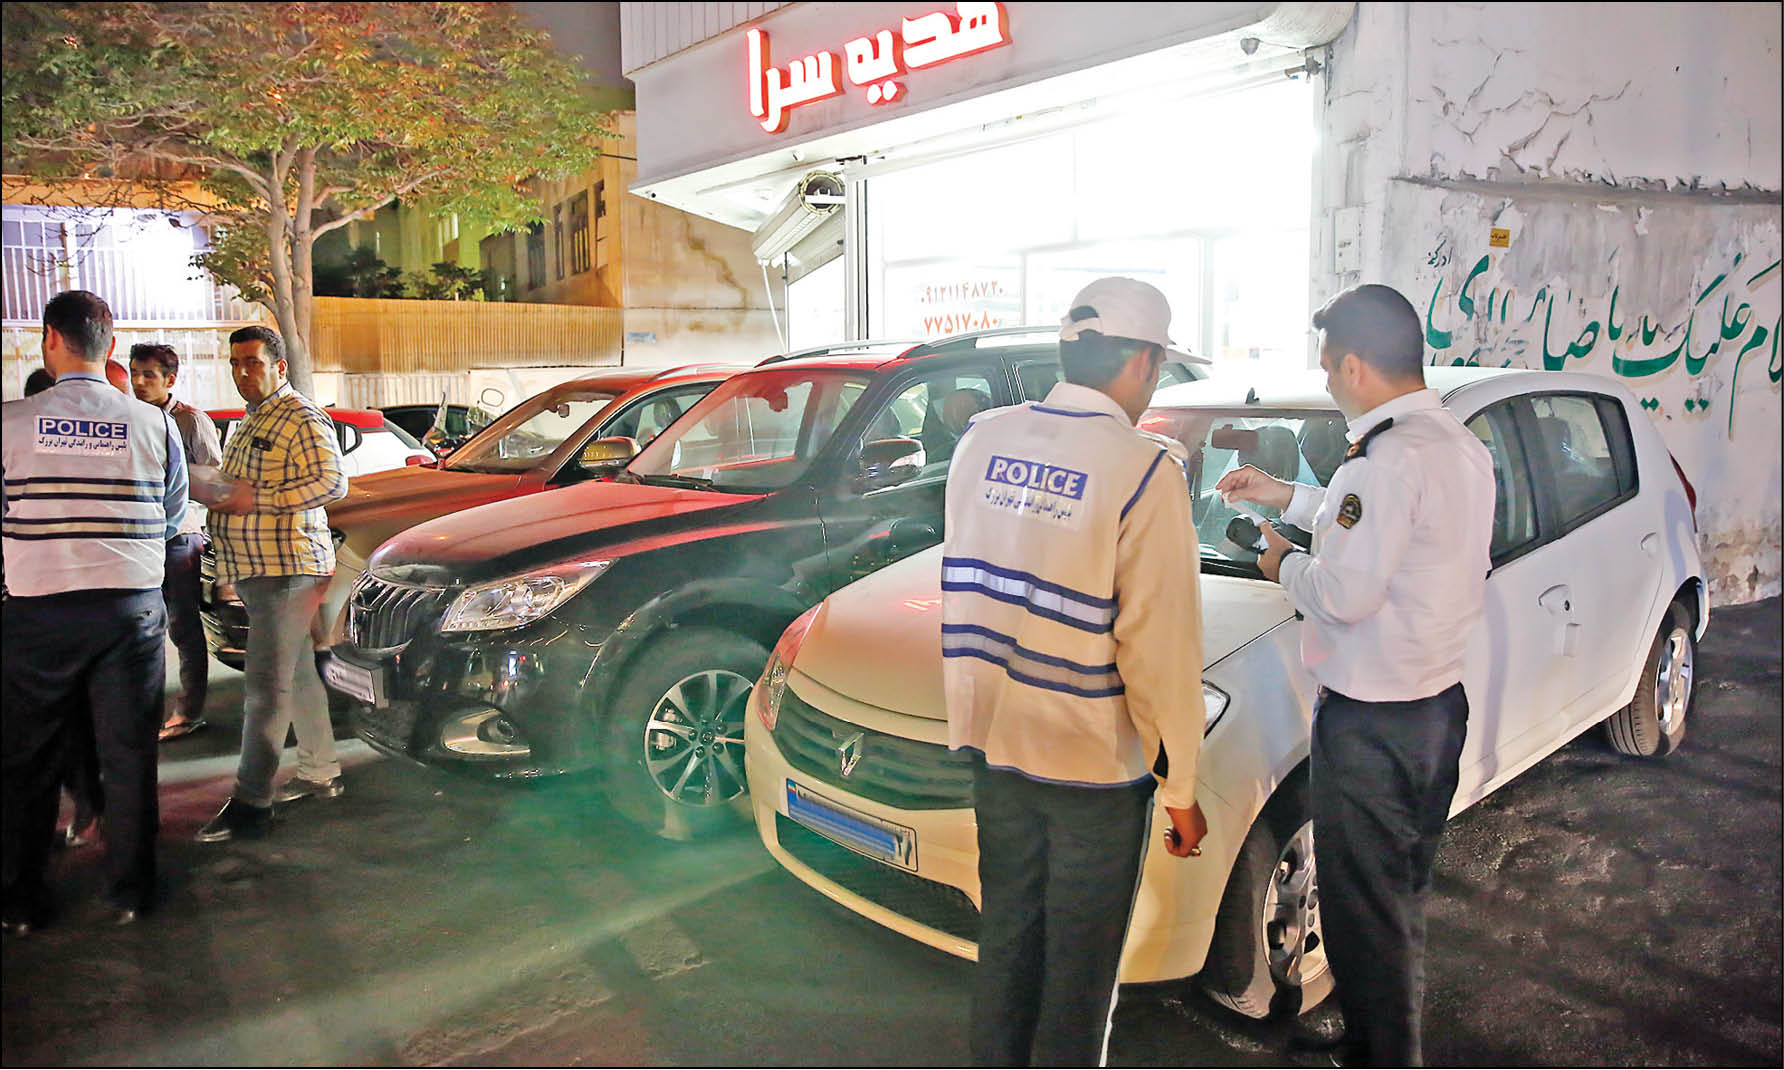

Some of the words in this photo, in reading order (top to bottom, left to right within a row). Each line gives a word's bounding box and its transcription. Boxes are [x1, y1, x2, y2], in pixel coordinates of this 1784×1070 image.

[747, 28, 844, 133] سرا
[41, 419, 125, 438] POLICE
[990, 459, 1081, 496] POLICE
